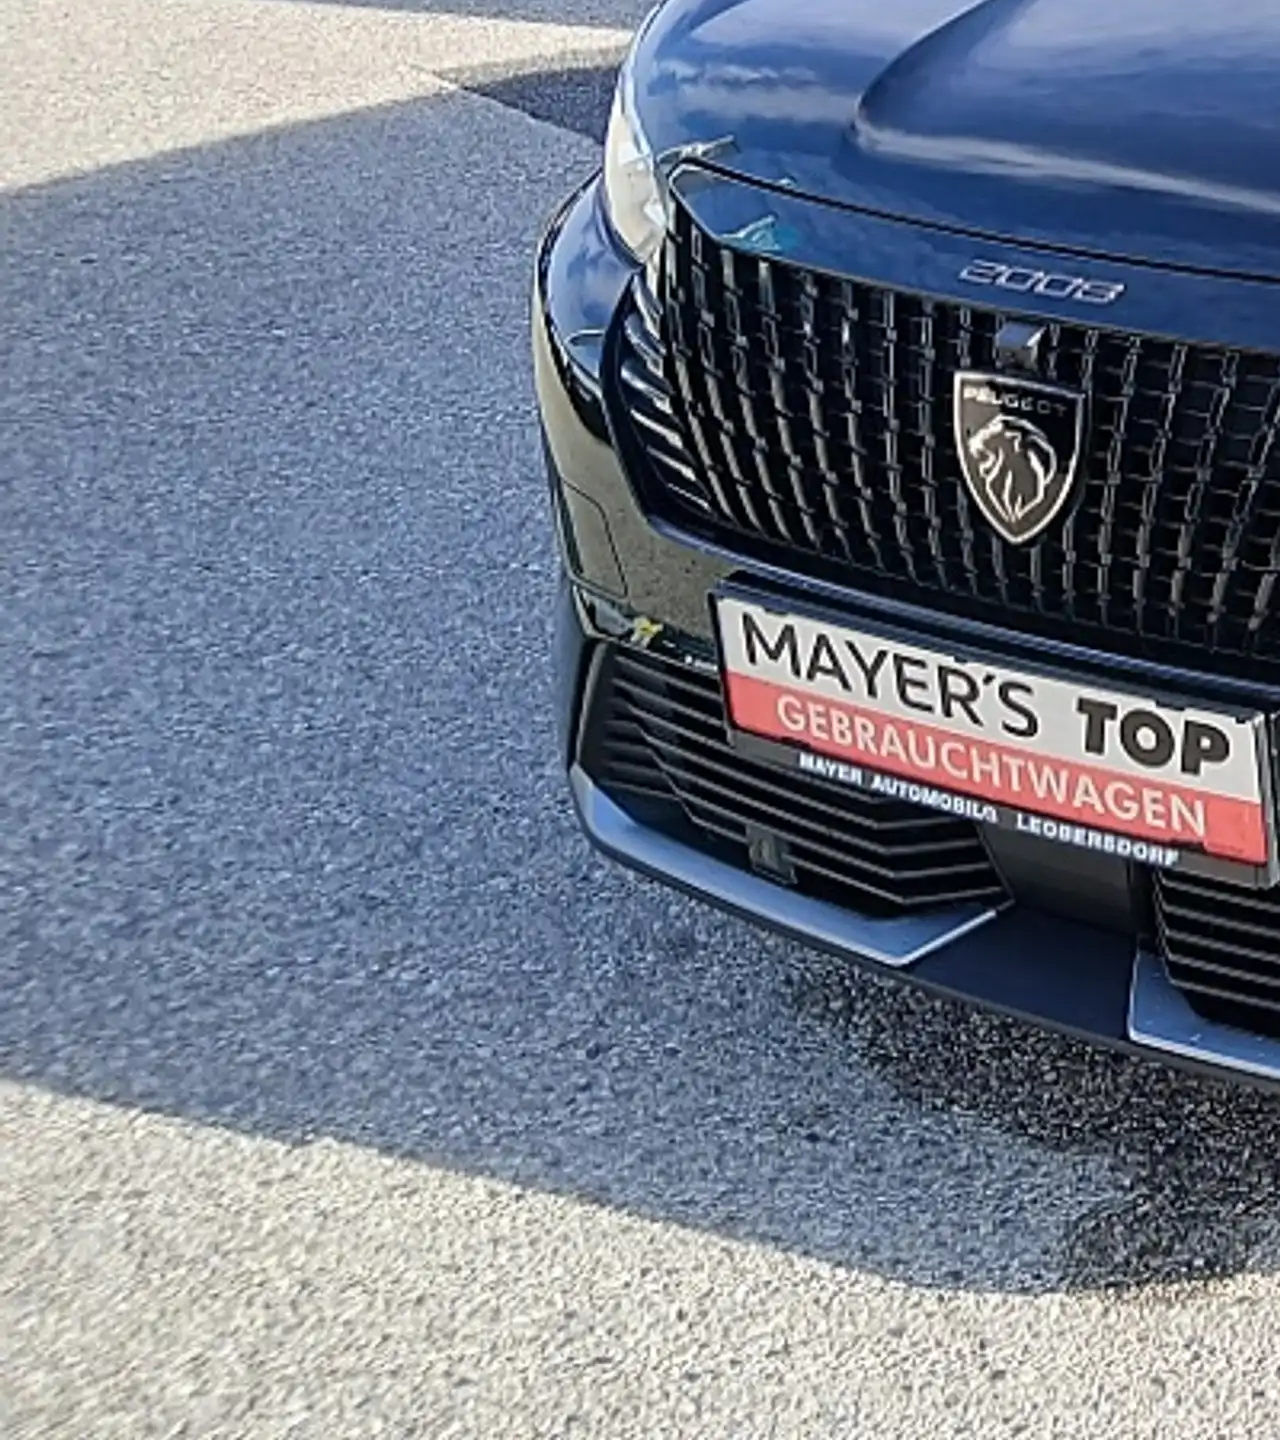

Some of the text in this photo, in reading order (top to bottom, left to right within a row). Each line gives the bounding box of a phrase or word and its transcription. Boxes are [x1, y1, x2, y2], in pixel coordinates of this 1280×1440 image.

[959, 259, 1126, 304] 2008
[742, 612, 1232, 775] MAYER'S TOP
[776, 695, 1207, 837] GEBRAUCHTWAGEN
[800, 752, 863, 786] MAYER
[1016, 812, 1180, 868] LEOBERSDORF
